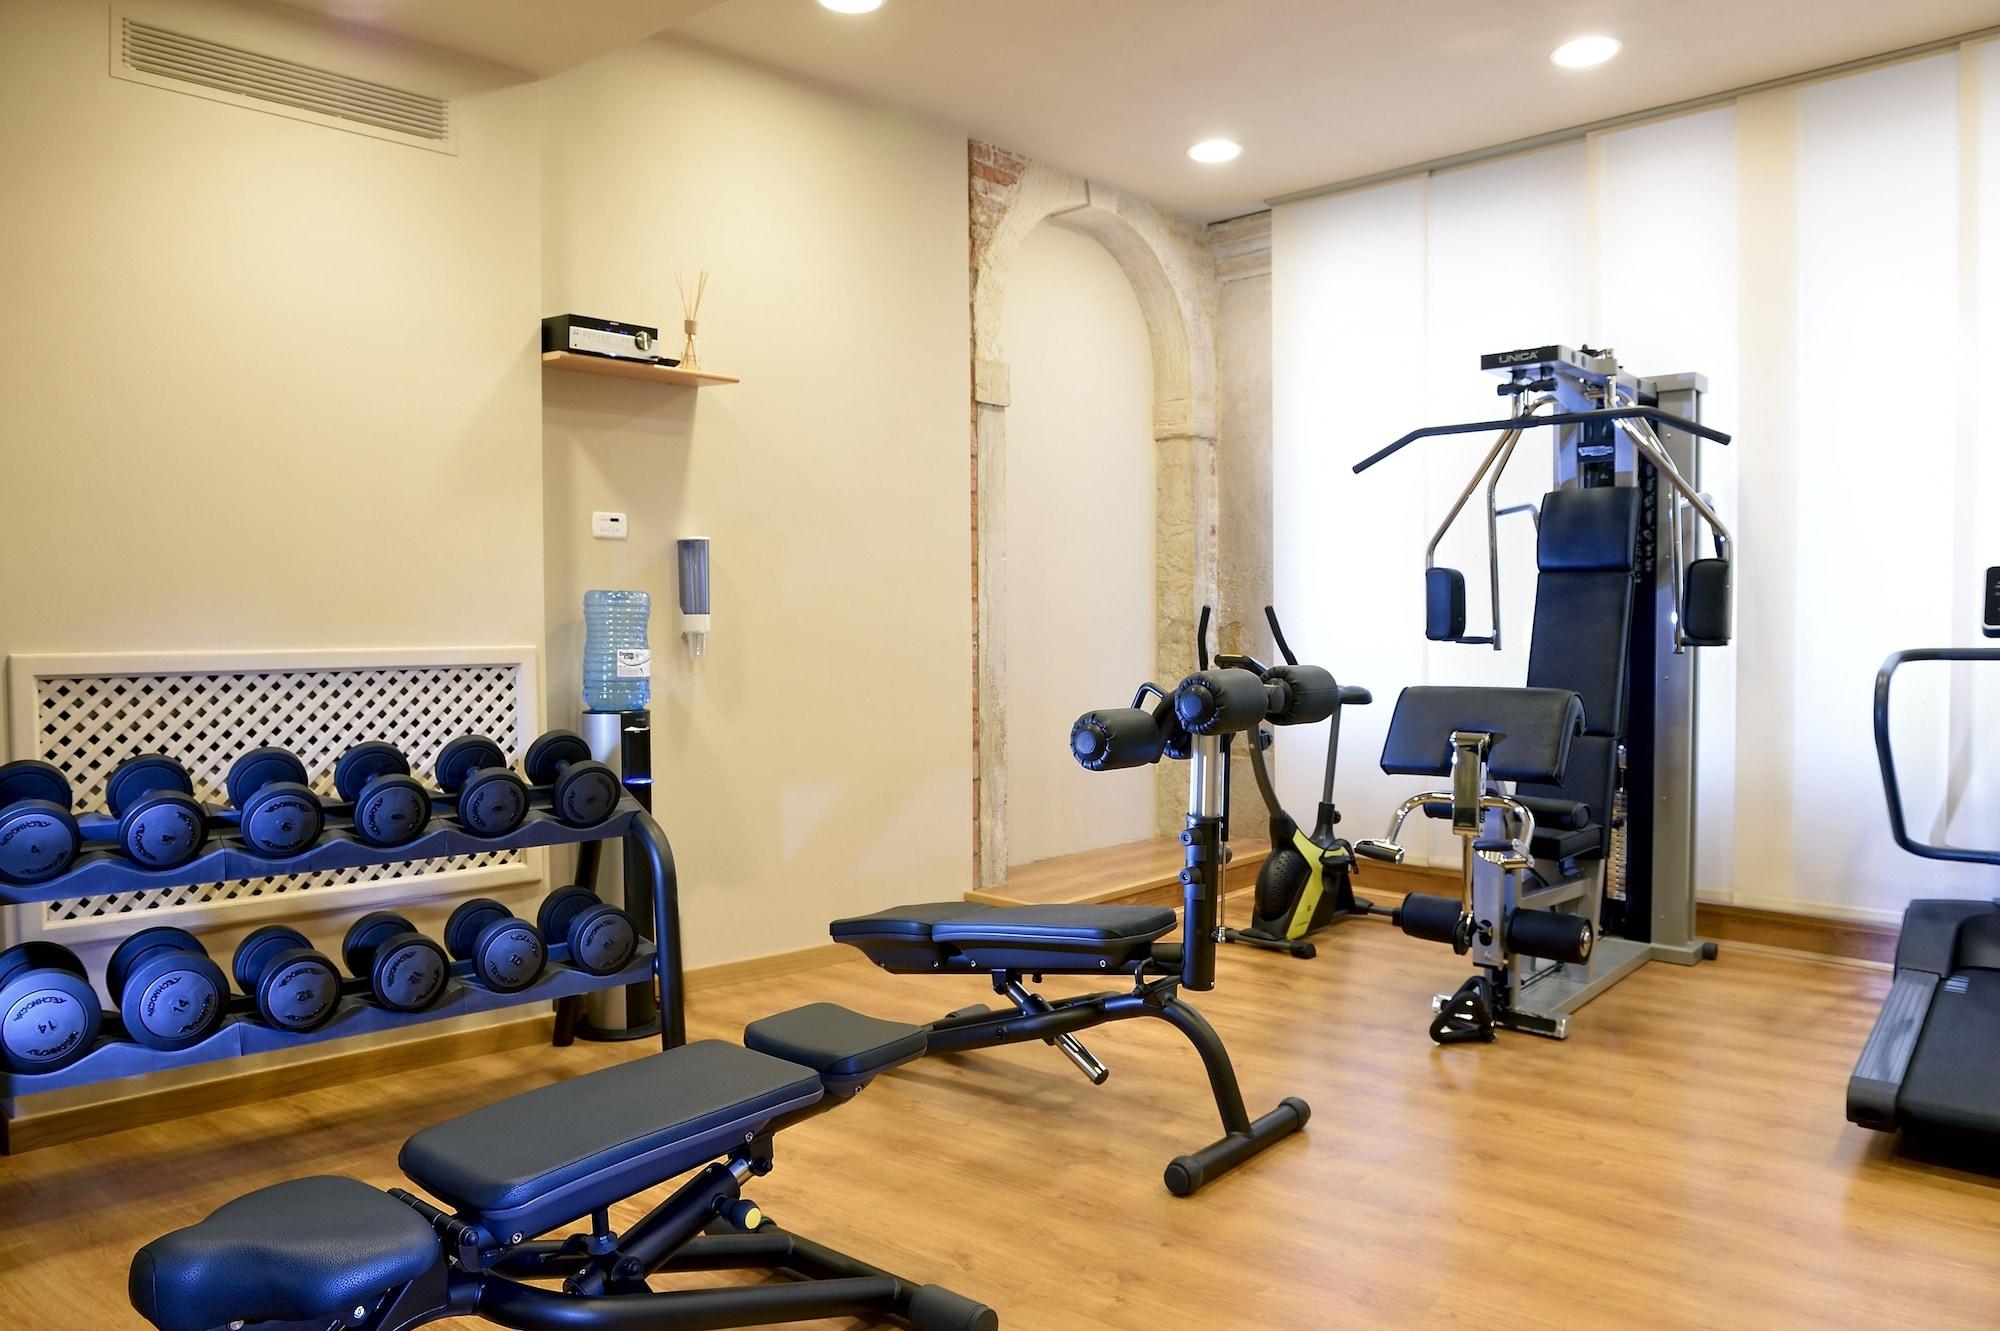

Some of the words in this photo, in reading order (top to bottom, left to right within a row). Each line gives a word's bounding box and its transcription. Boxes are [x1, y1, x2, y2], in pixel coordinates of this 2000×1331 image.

[1498, 351, 1537, 363] UNICA
[173, 998, 191, 1013] 14
[37, 1020, 57, 1034] 14
